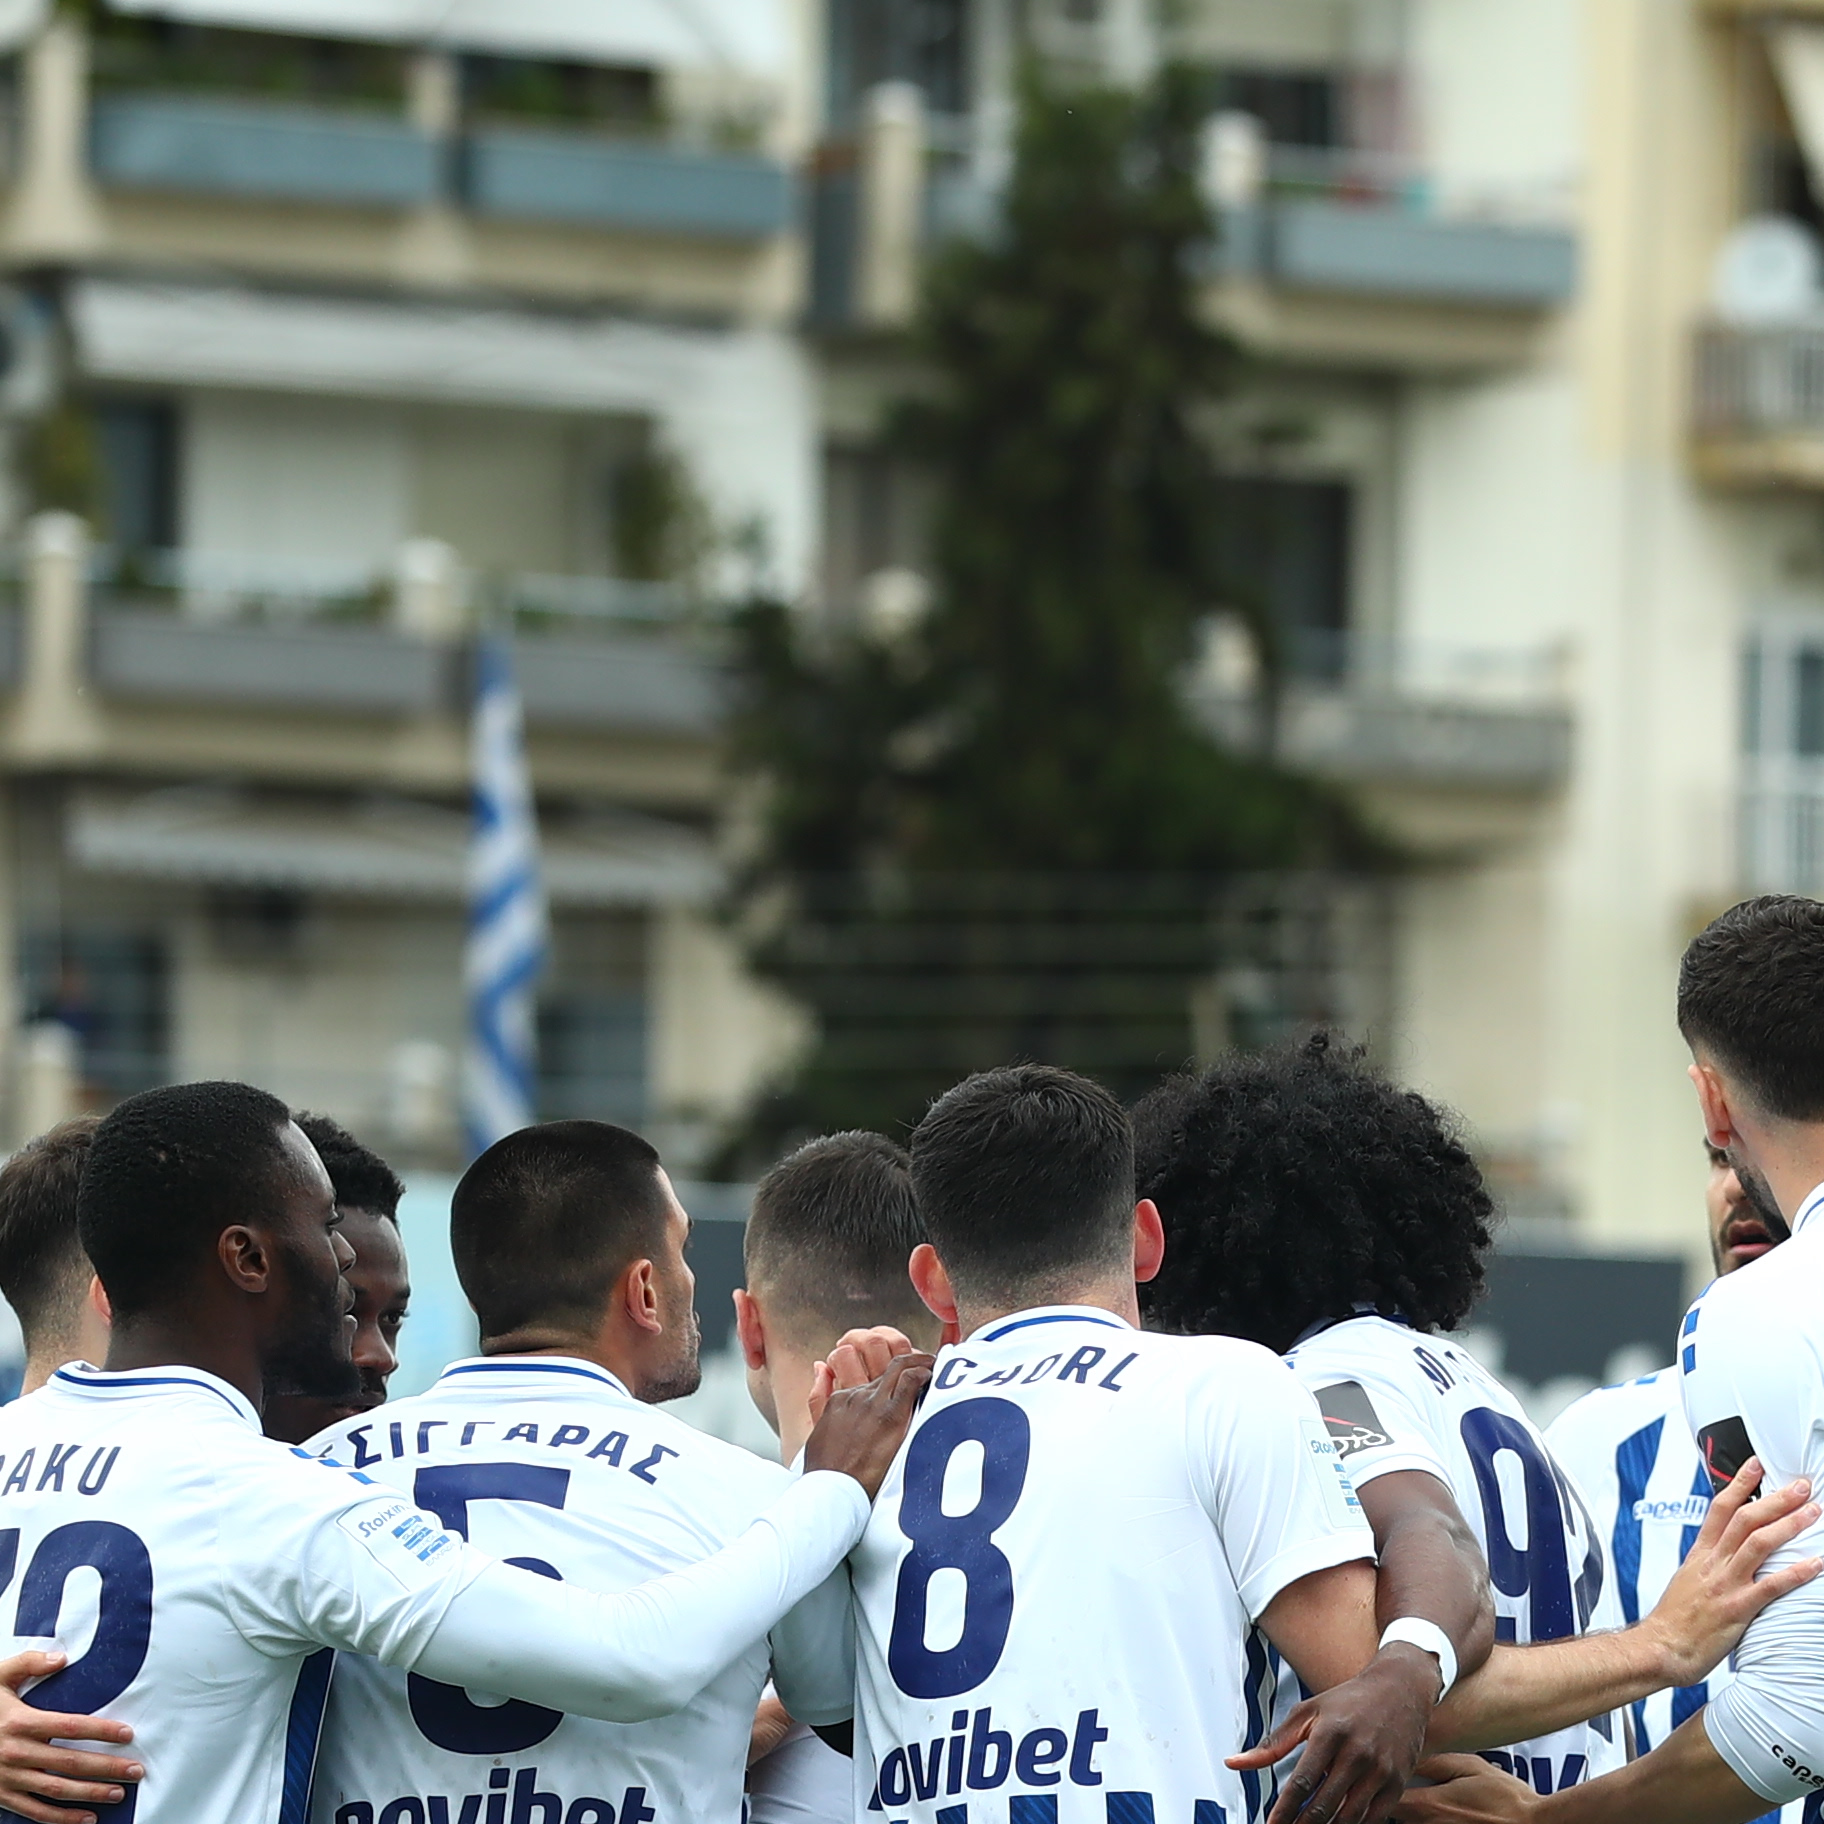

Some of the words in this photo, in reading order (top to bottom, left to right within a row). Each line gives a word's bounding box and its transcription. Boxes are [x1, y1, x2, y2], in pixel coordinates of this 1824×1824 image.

[933, 1344, 1140, 1393] CHORL
[318, 1421, 681, 1486] ΣΙΓΓΑΡΑΣ
[887, 1396, 1031, 1700] 8
[867, 1707, 1109, 1812] ovibet
